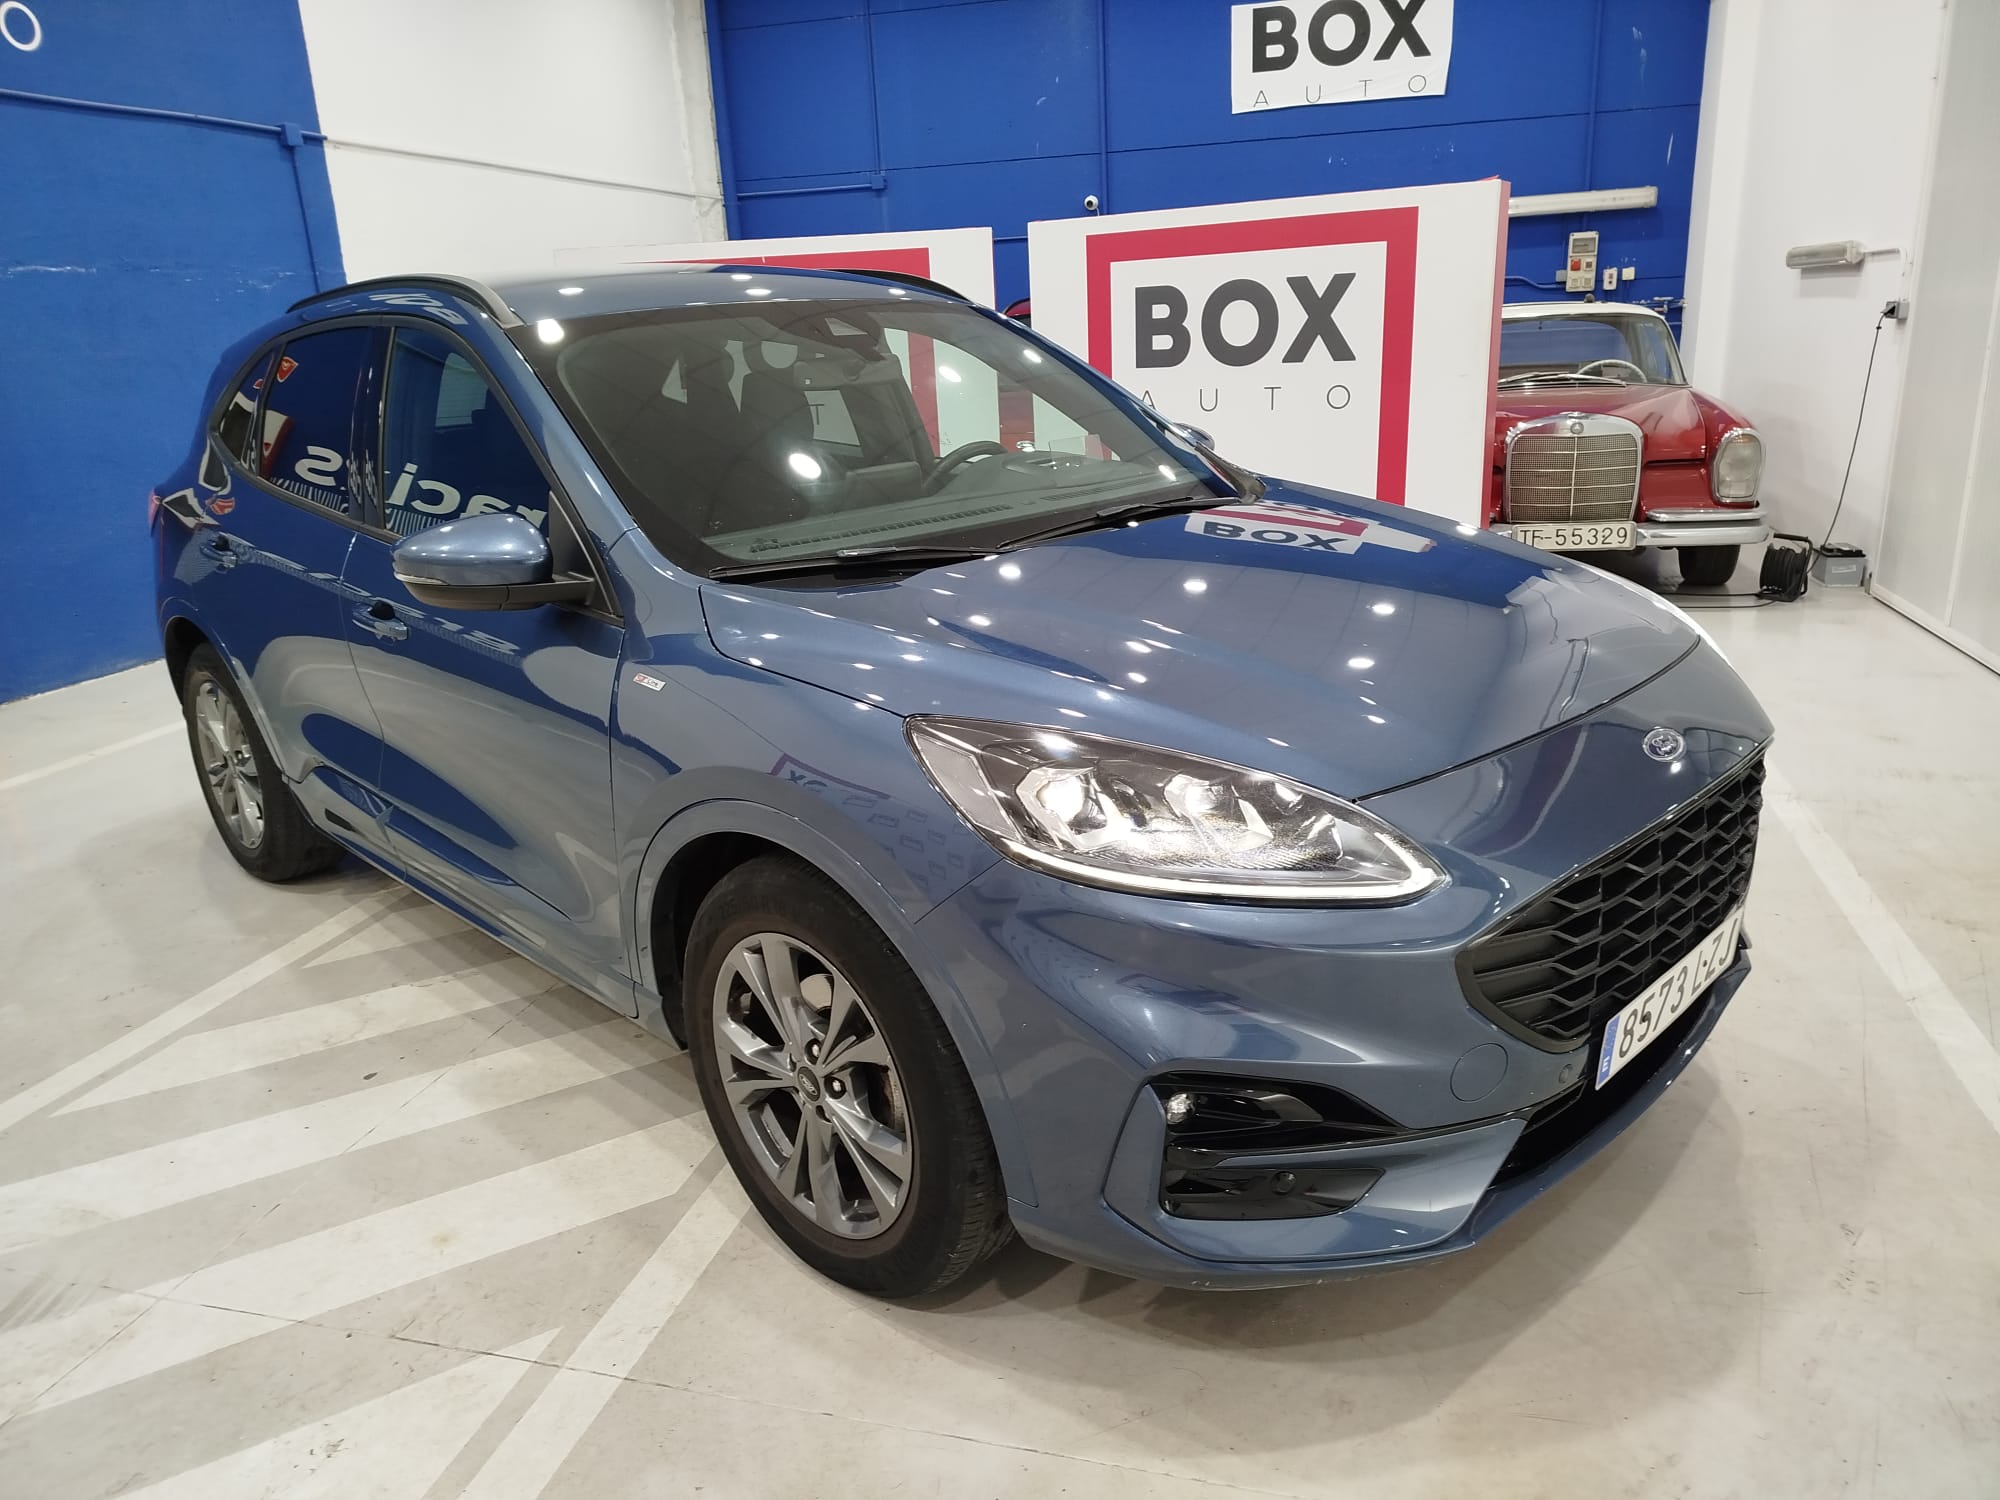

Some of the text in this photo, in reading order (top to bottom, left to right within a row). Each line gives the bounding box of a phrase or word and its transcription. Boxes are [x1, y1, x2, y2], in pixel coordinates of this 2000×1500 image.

[1252, 0, 1432, 73] BOX
[1253, 75, 1427, 107] AUTO
[1135, 272, 1357, 368] BOX
[1141, 384, 1351, 412] AUTO
[1619, 918, 1738, 1058] 8573 LZJ
